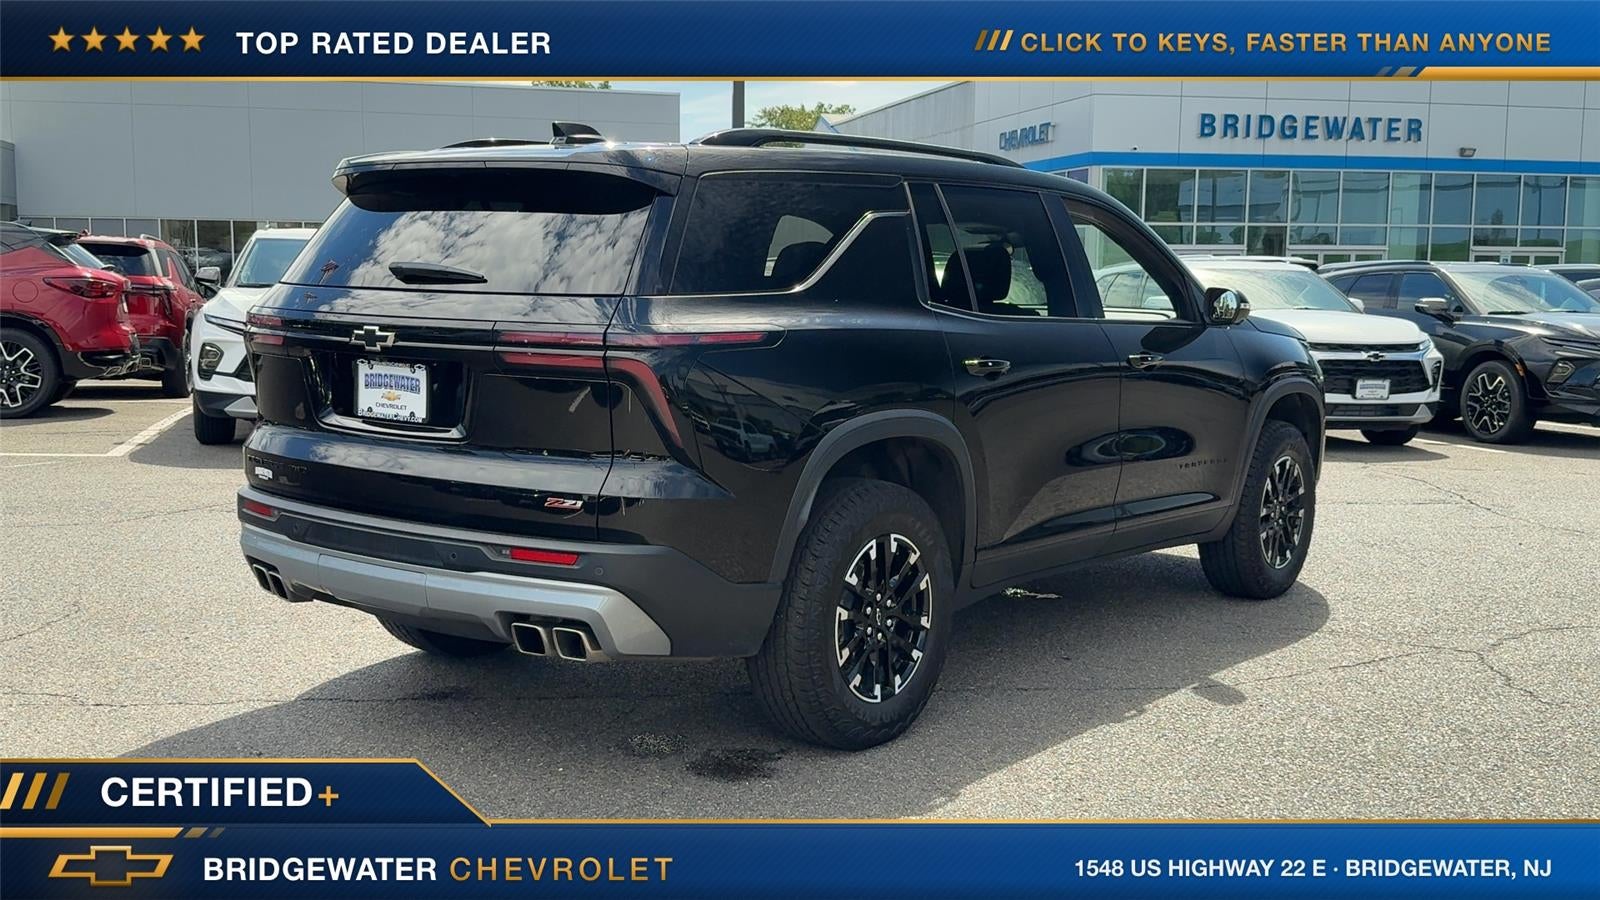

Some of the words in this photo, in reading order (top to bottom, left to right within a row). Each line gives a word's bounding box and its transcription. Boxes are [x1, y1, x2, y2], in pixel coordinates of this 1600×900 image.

[999, 121, 1056, 151] CHEVROLET
[1198, 112, 1423, 142] BRIDGEWATER
[364, 373, 421, 394] BRIDGEWATER
[375, 402, 407, 411] CHEVROLET
[545, 497, 584, 510] Z71
